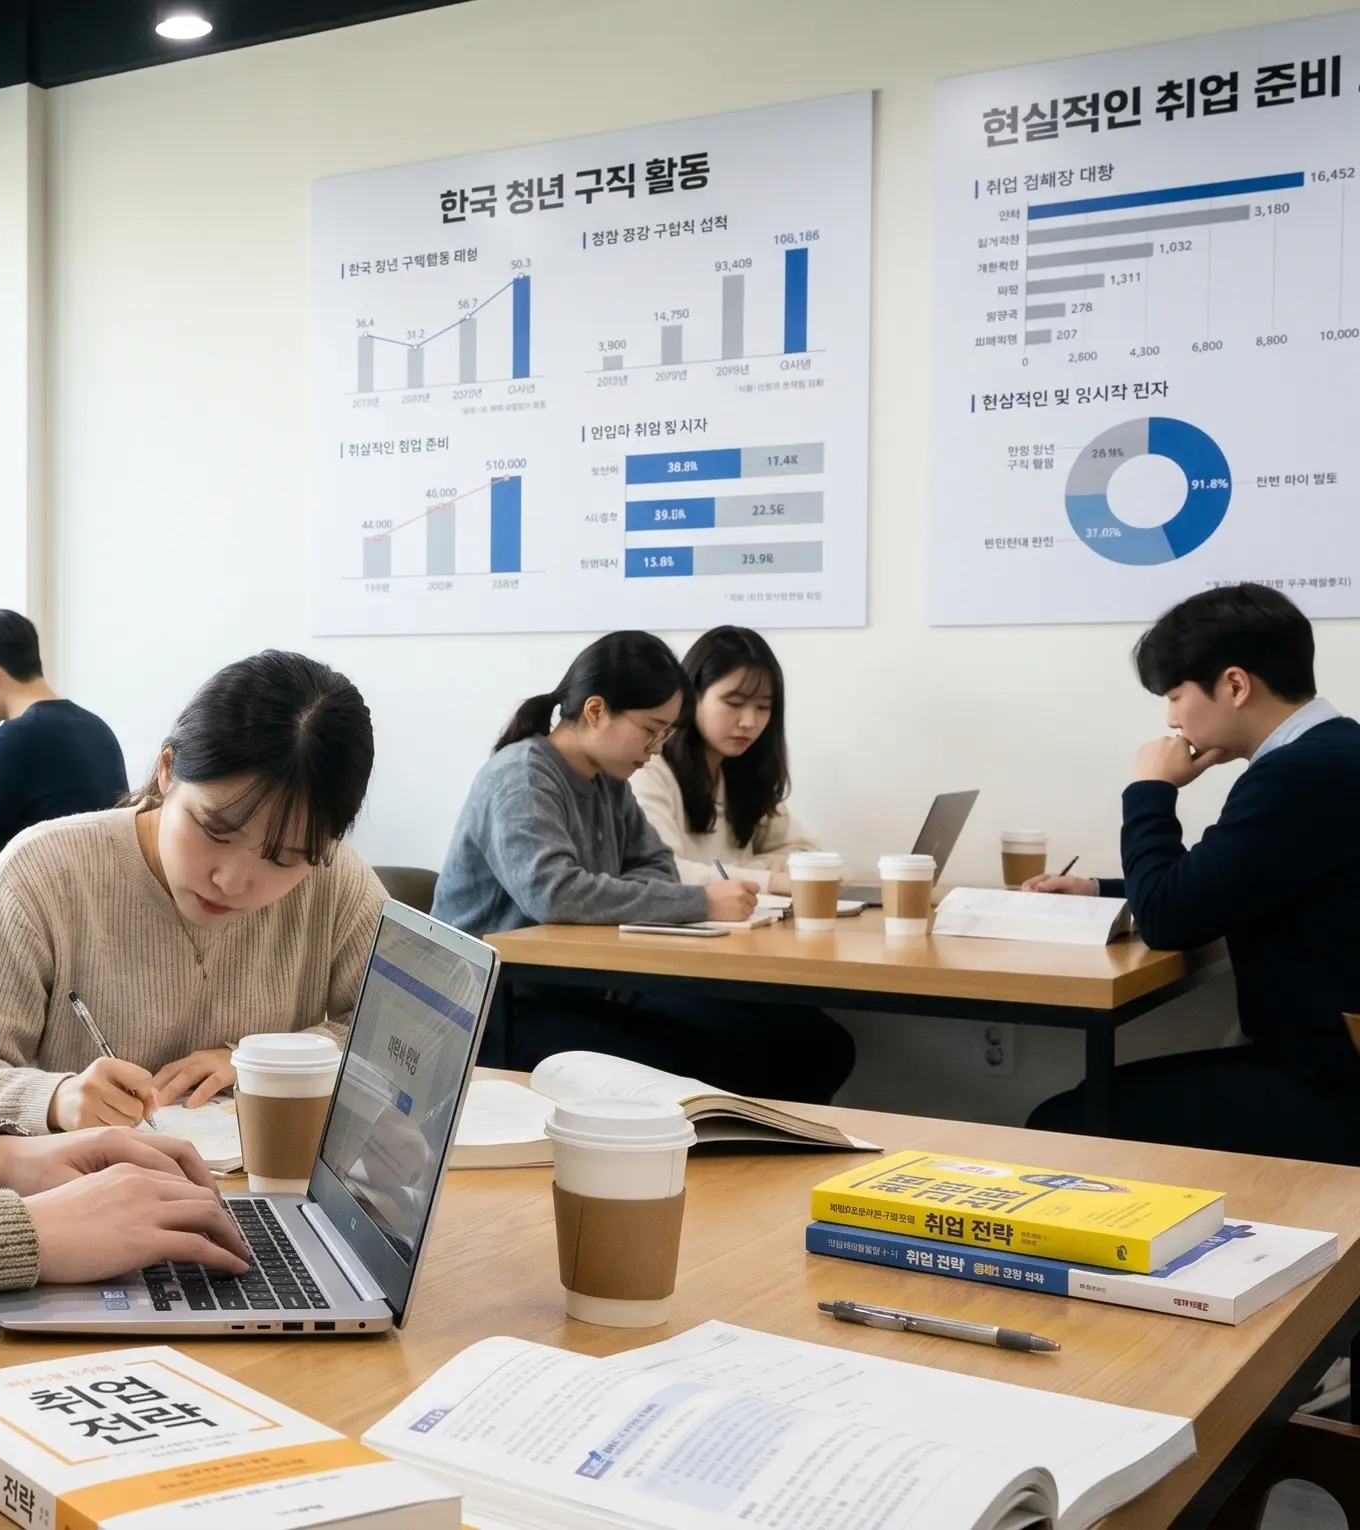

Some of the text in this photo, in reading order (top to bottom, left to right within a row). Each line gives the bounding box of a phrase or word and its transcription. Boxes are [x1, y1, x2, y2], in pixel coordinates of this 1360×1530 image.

[983, 55, 1341, 148] 현실적인 취업 준비
[1310, 167, 1356, 183] 16,452
[439, 152, 711, 224] 한국 청년 구직 활동
[986, 176, 1018, 196] 취업
[1254, 203, 1291, 218] 3,180
[1159, 240, 1193, 255] 1,032
[714, 257, 753, 272] 93,409
[1110, 272, 1142, 287] 1,311
[653, 308, 690, 322] 14,750
[1070, 302, 1093, 315] 278
[1055, 329, 1078, 341] 207
[1319, 327, 1360, 342] 10,000
[597, 339, 627, 352] 3,900
[1191, 478, 1229, 491] 91.8%
[924, 1211, 965, 1239] 취업
[971, 1219, 1013, 1247] 전략
[905, 1249, 934, 1269] 취업
[28, 1375, 170, 1415] 취업
[69, 1402, 219, 1445] 전략
[2, 1465, 36, 1524] 전략
